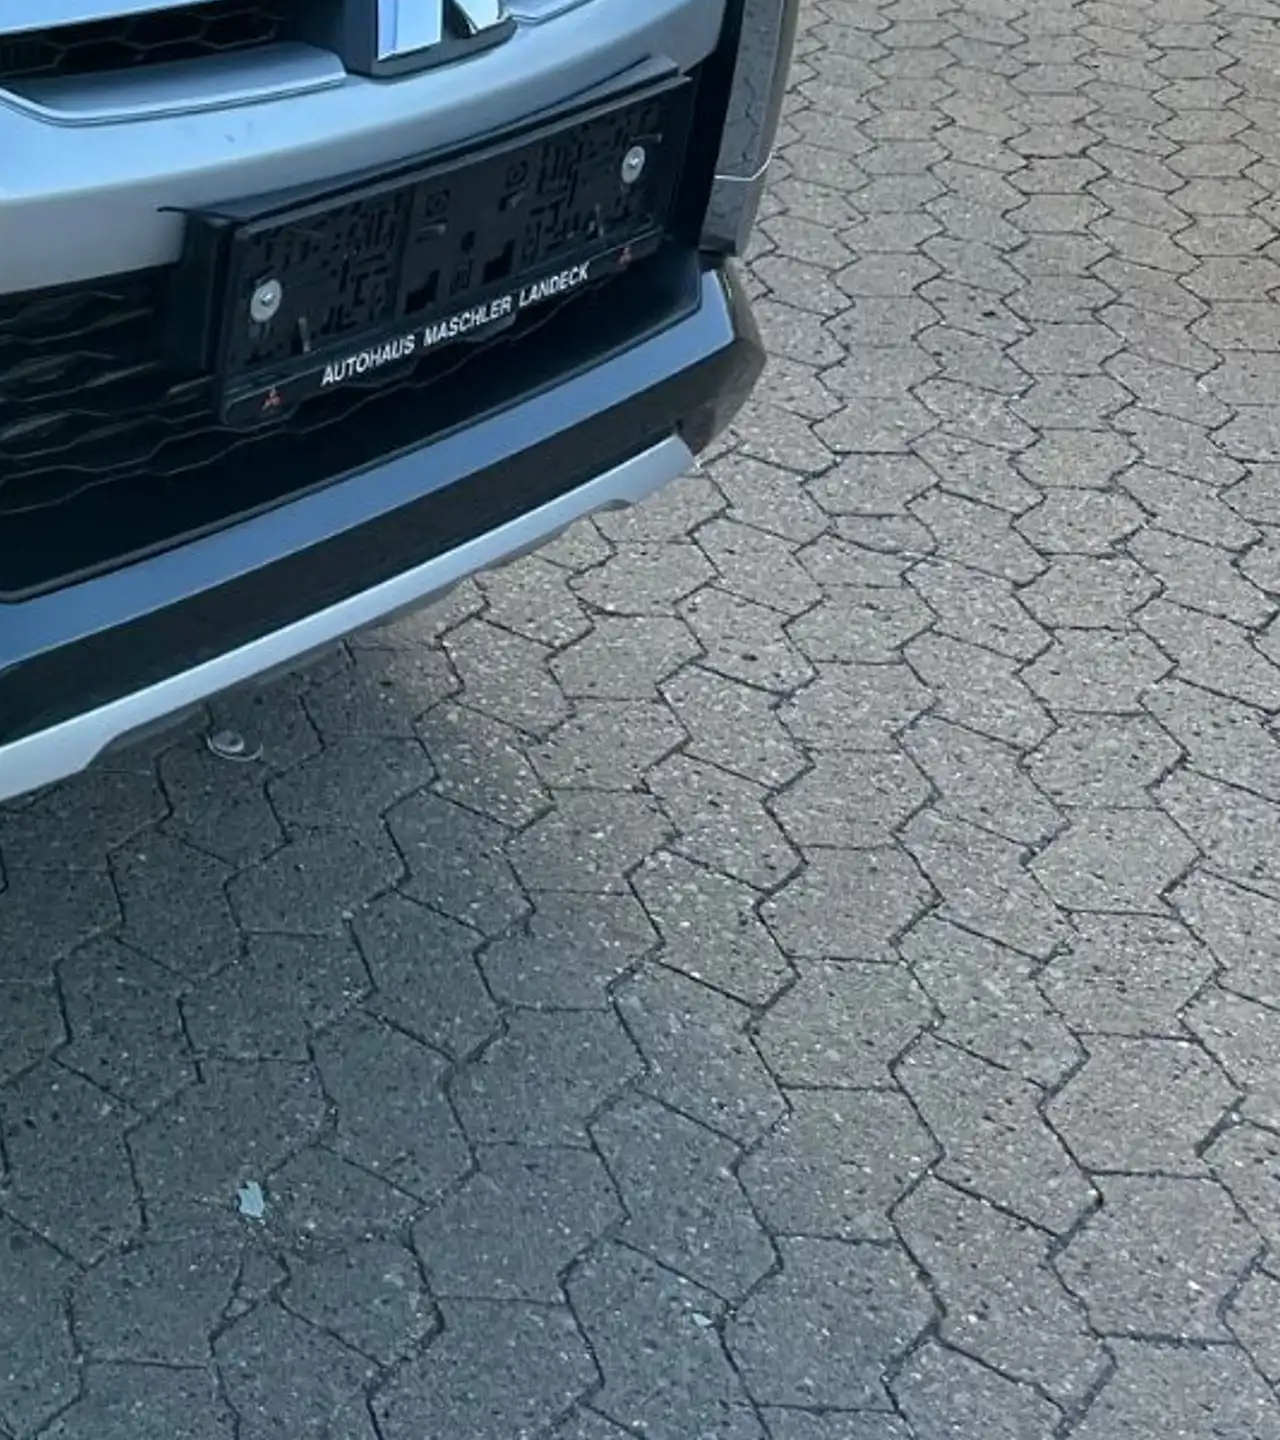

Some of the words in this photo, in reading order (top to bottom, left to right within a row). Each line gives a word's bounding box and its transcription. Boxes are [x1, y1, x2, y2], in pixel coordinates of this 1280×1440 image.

[321, 334, 416, 387] AUTOHAUS
[423, 295, 513, 347] MASCHLER
[518, 259, 591, 307] LANDECK
